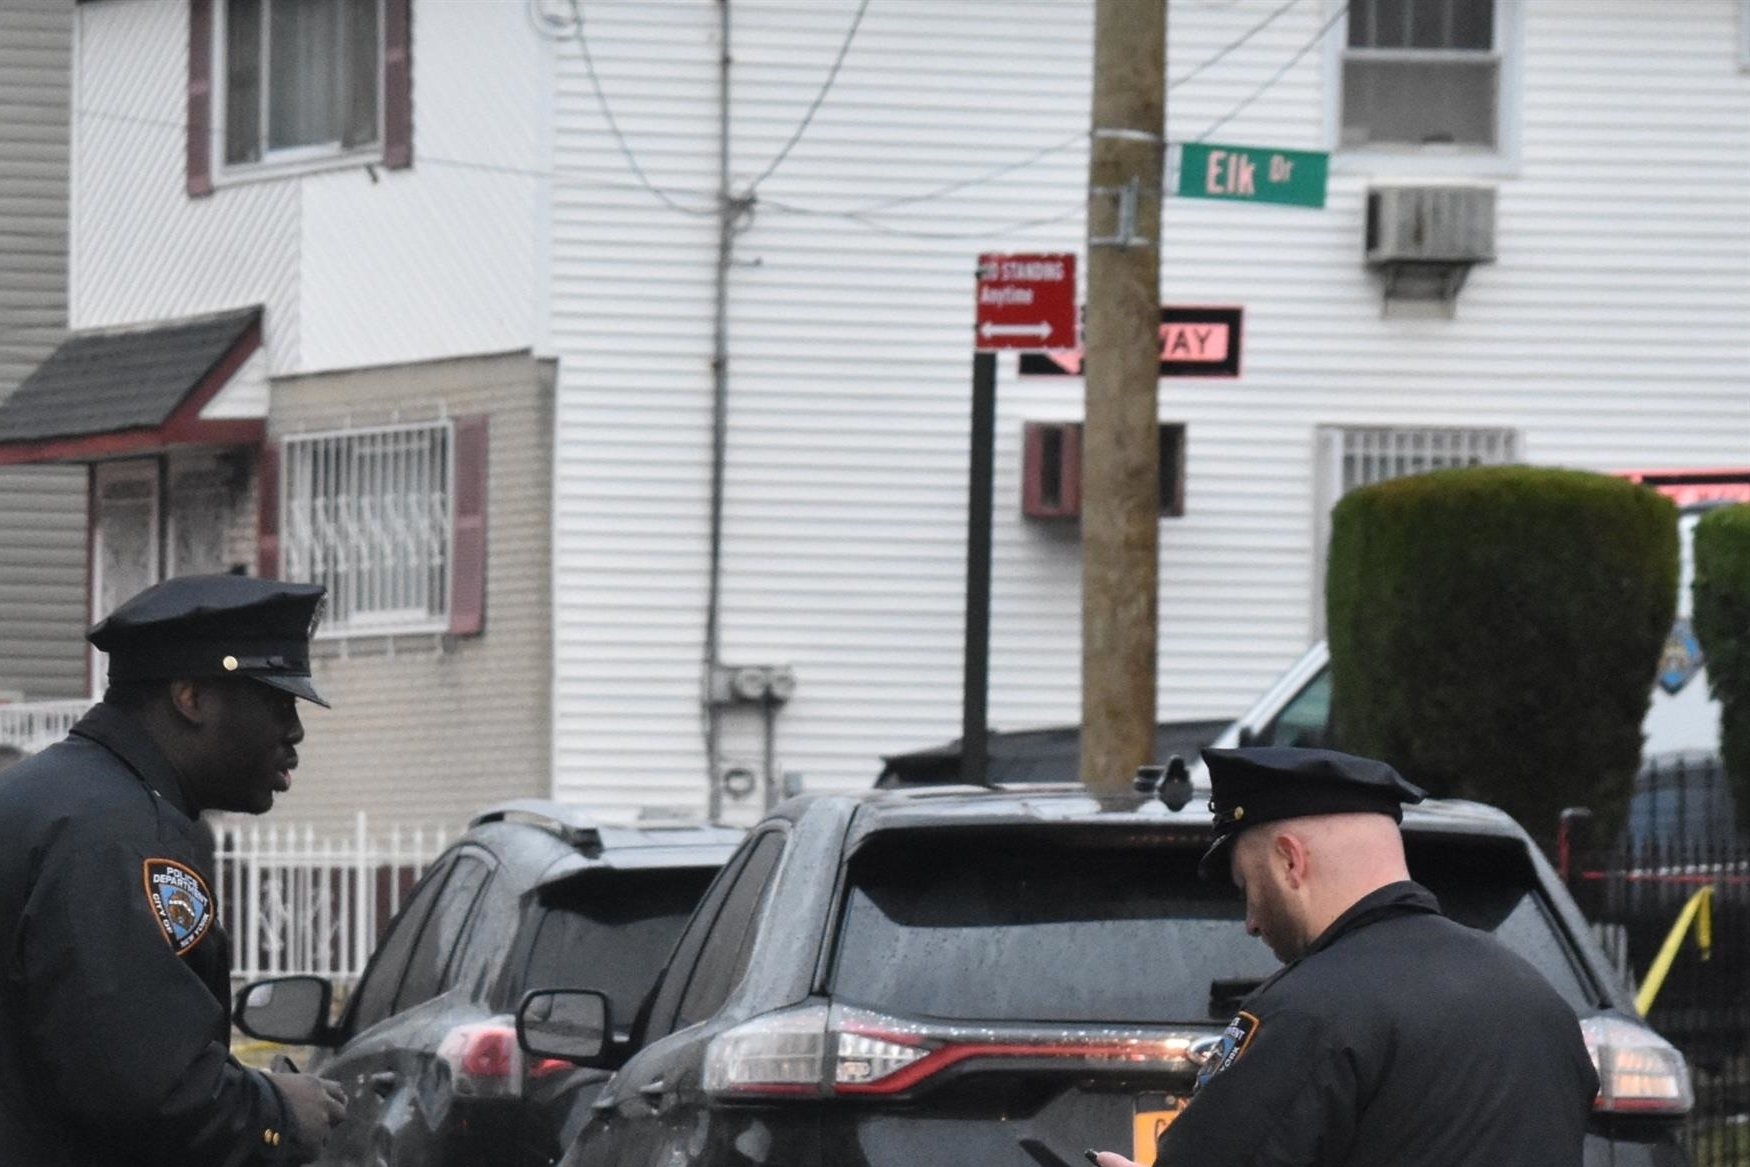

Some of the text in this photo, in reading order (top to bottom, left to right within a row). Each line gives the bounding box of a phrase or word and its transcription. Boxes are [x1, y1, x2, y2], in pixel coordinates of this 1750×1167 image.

[1206, 150, 1255, 194] Elk
[1002, 262, 1065, 281] STANDING
[166, 866, 198, 889] POLICE
[153, 874, 208, 907] DEPARTMENT
[153, 893, 166, 916] CITY
